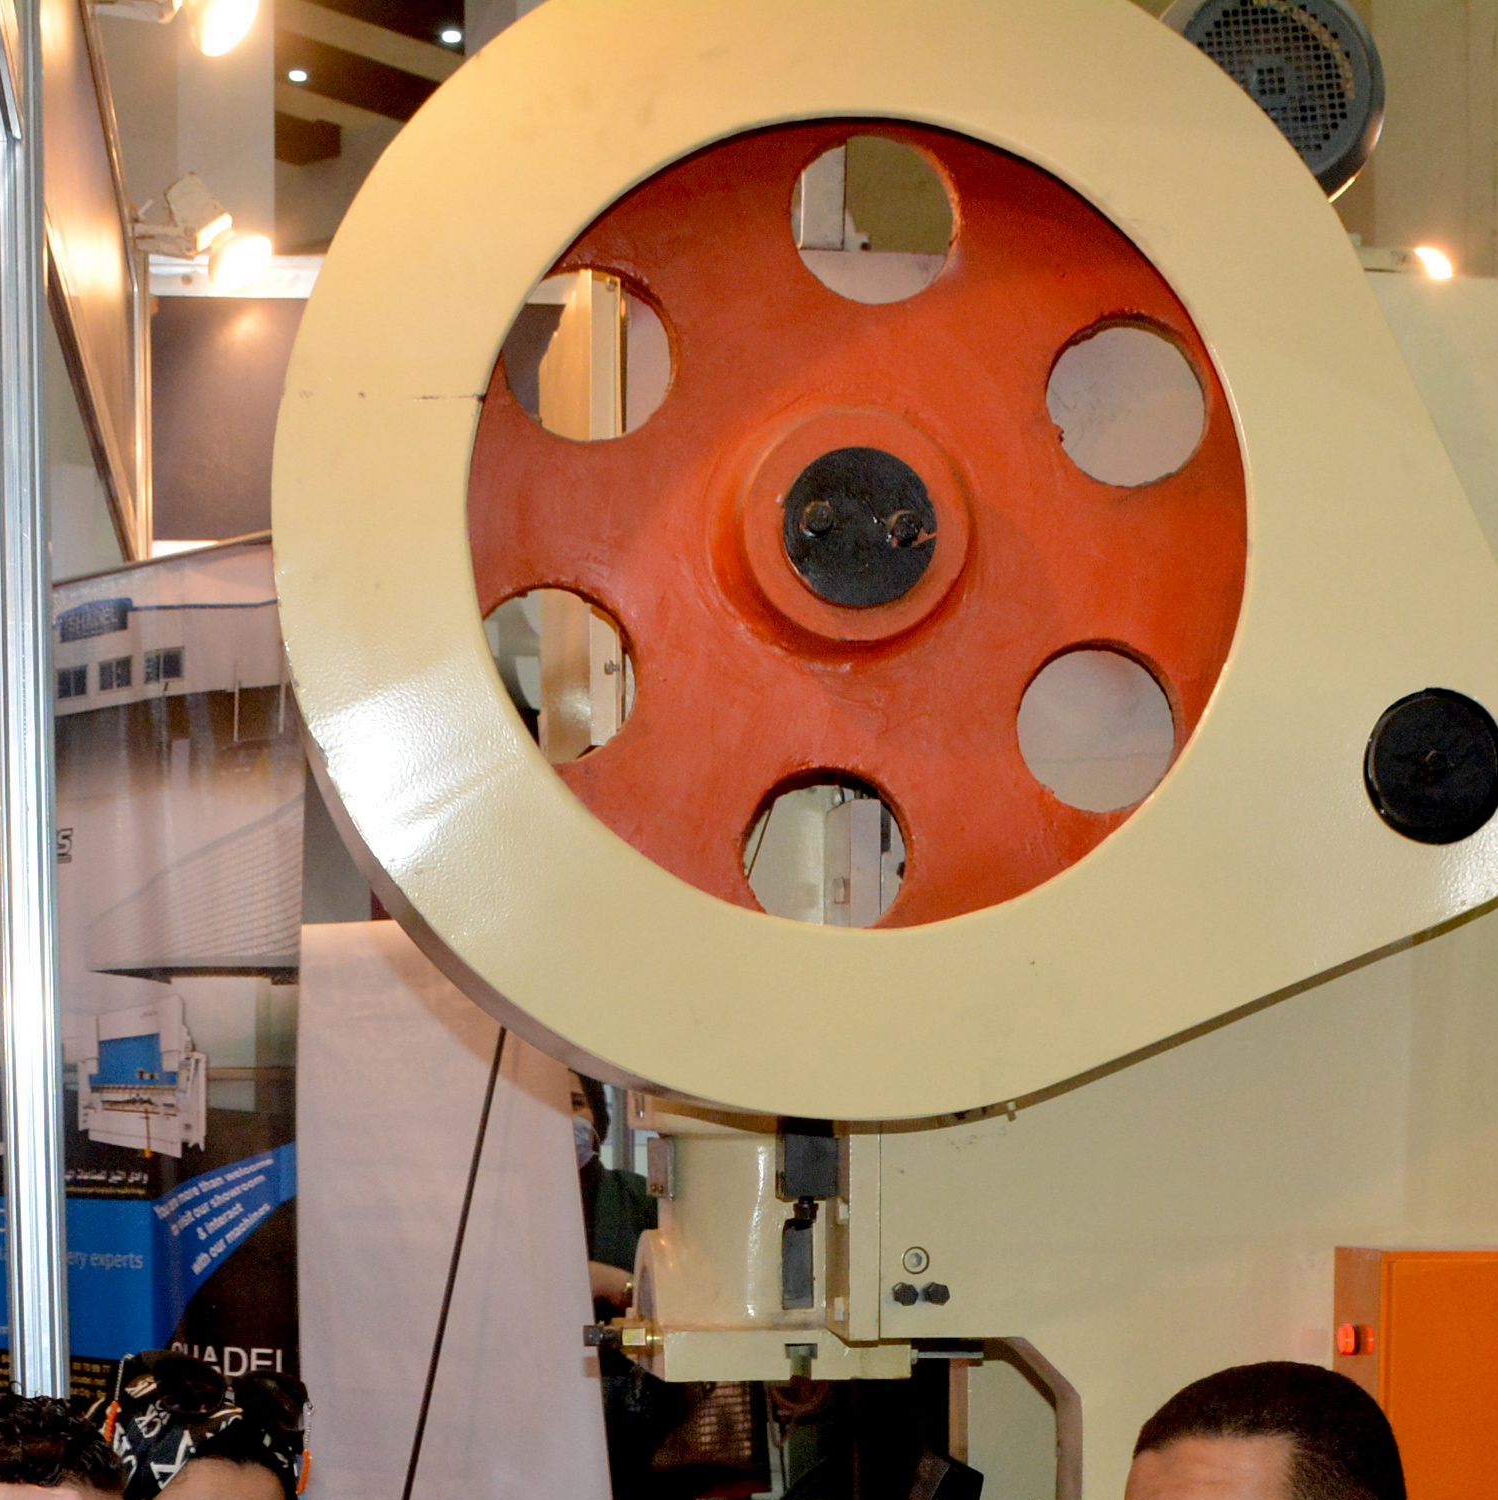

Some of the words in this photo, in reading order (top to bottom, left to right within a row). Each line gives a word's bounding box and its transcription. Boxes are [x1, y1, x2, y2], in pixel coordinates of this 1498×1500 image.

[198, 1176, 225, 1193] than
[224, 1158, 274, 1182] welcome
[210, 1174, 267, 1209] showroom
[90, 1252, 144, 1270] experts
